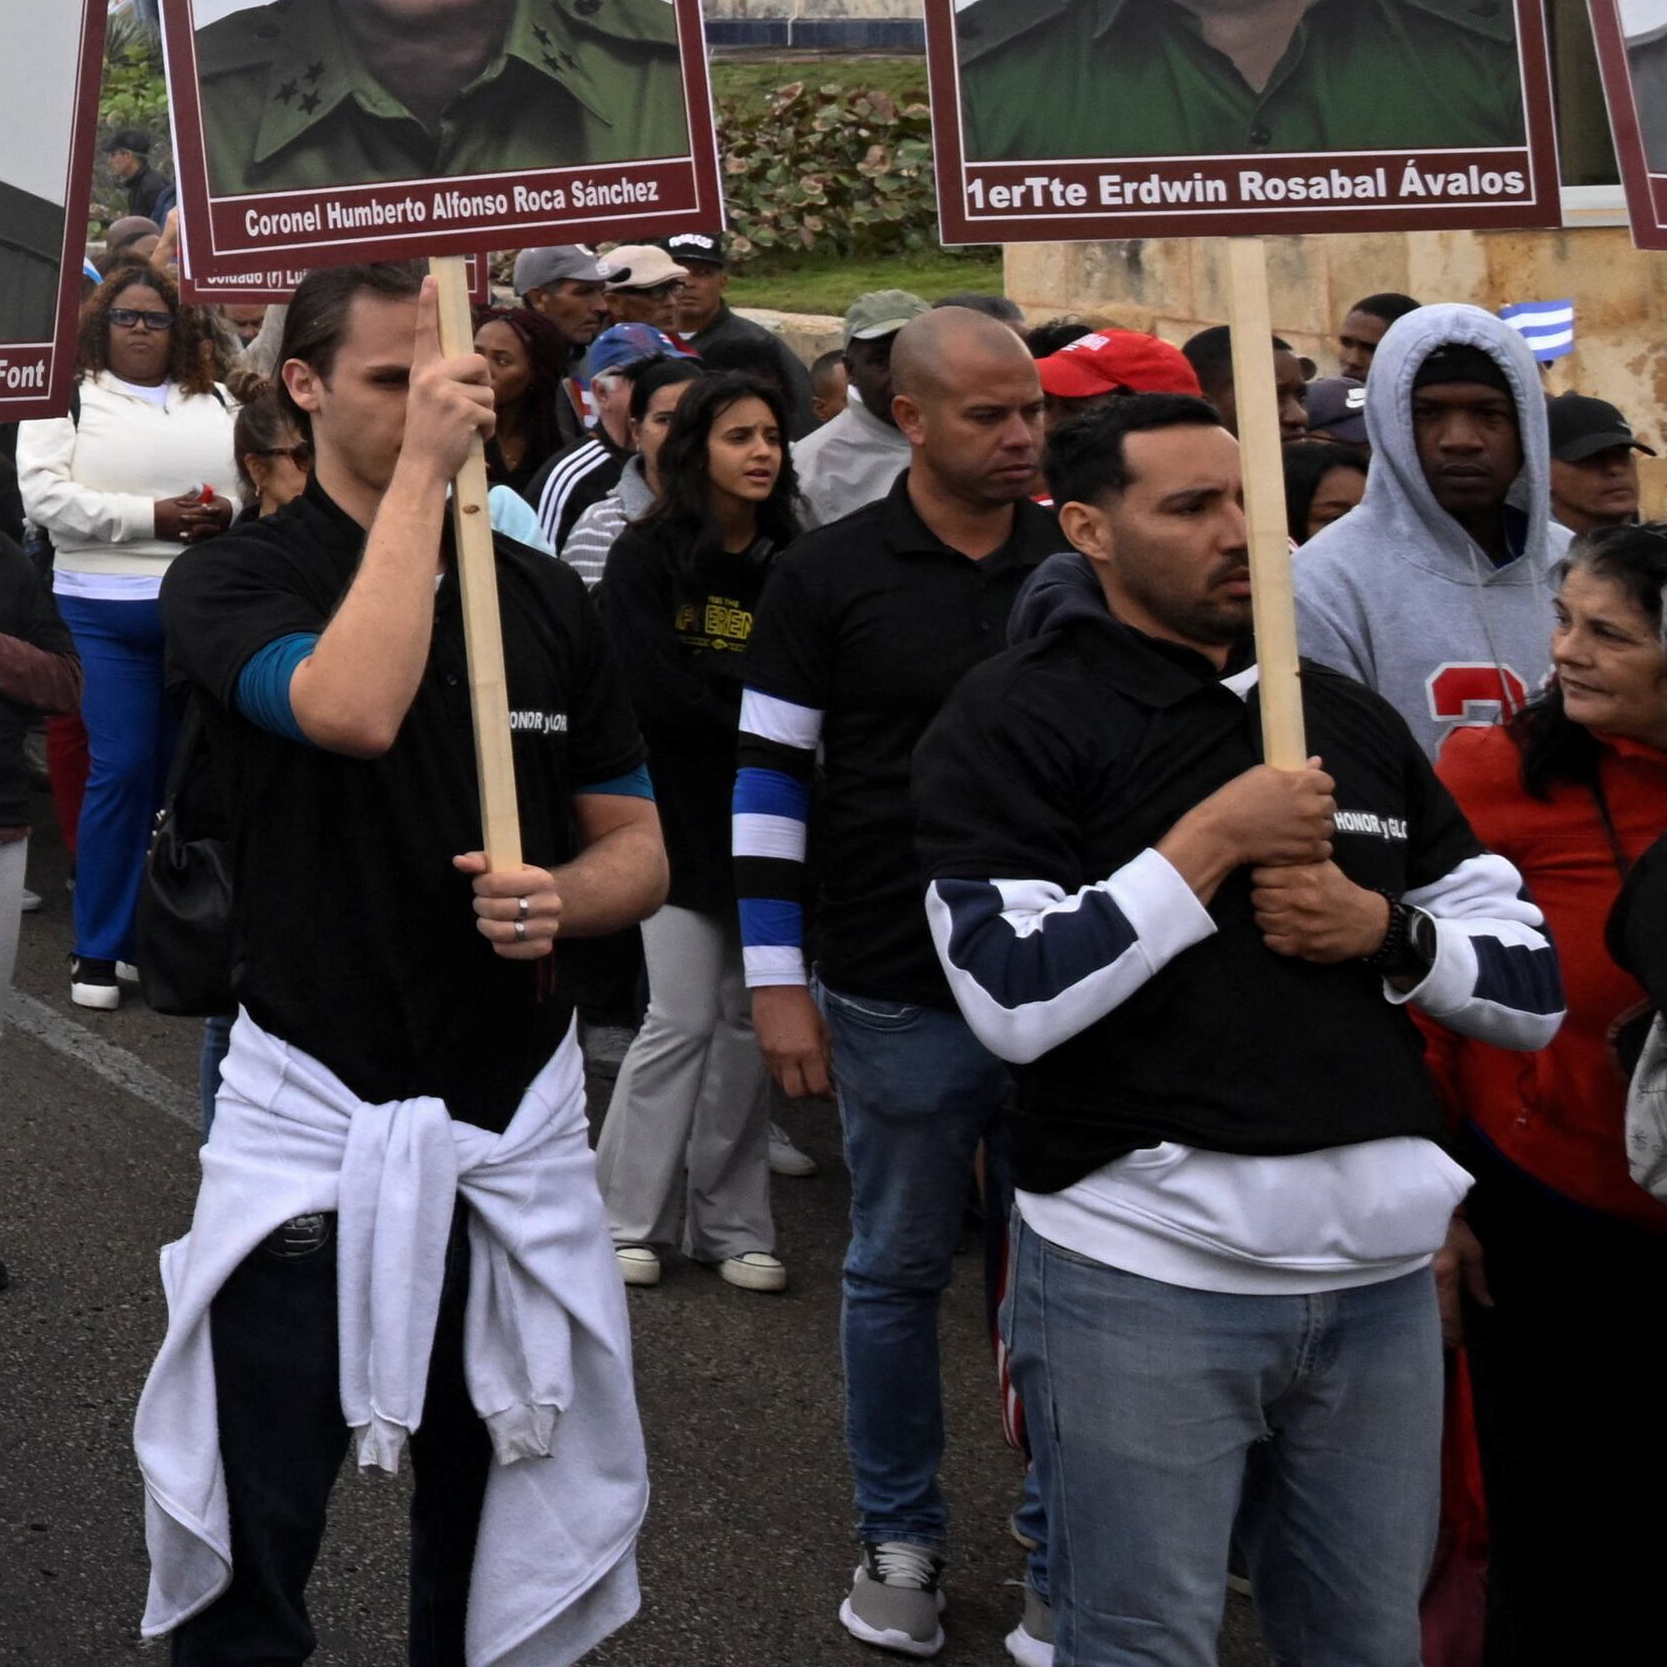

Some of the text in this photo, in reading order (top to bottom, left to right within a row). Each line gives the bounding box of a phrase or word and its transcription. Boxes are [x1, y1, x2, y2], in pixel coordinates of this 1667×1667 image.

[246, 177, 660, 237] Coronel Humberto Alfonso Roca Sánchez
[967, 160, 1525, 209] 1erTte Erdwin Rosabal Ávalos
[1334, 812, 1381, 833] HONOR
